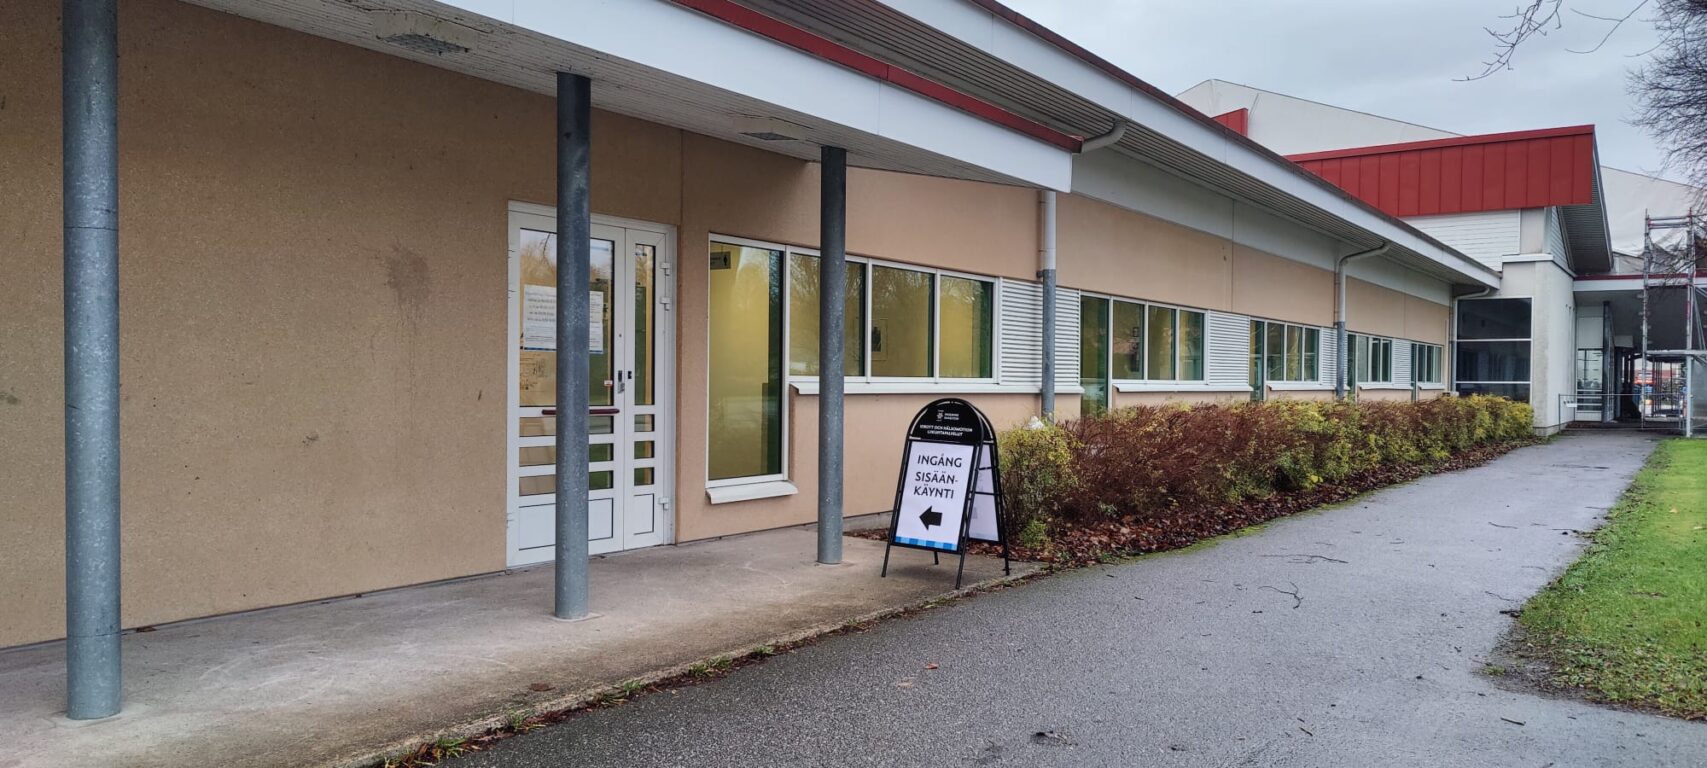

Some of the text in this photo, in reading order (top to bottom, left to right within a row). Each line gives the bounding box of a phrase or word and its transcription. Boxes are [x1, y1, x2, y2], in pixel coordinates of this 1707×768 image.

[917, 453, 962, 468] INGÅNG
[915, 470, 958, 485] SISÄÄN-
[913, 483, 954, 499] KÄYNTI
